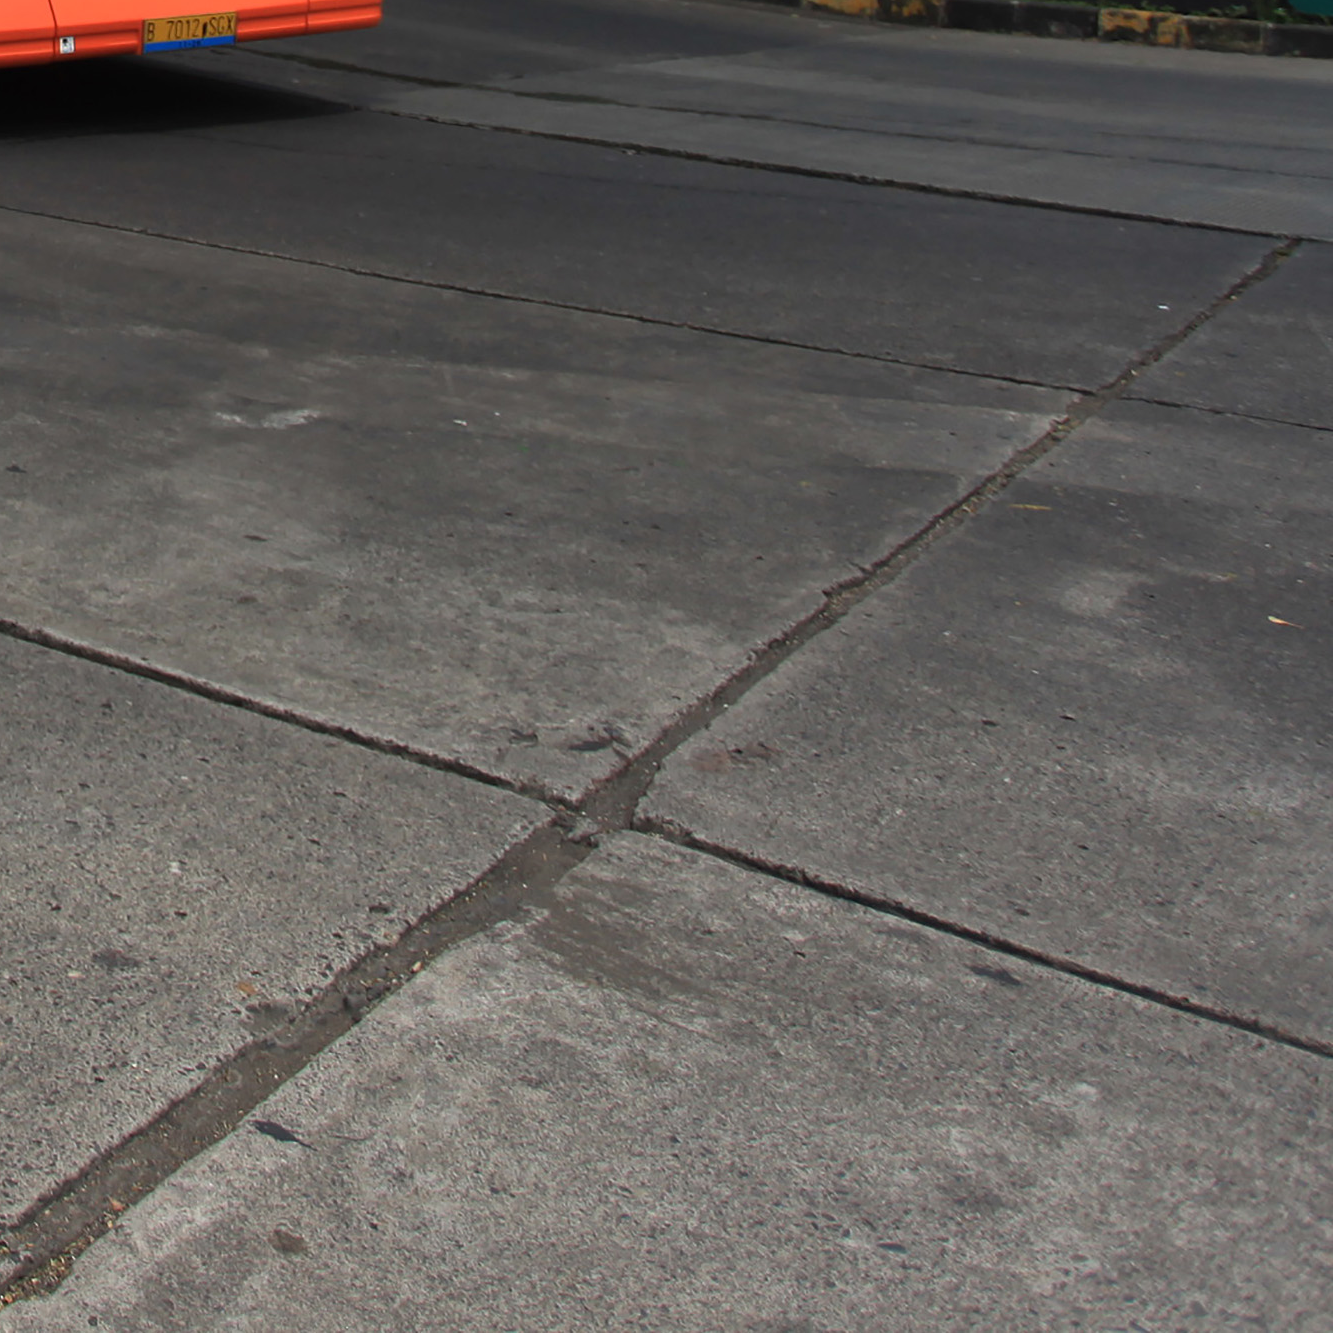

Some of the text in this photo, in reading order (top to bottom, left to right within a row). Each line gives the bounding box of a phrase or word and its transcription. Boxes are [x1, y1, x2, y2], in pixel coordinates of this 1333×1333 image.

[147, 15, 234, 42] B 7012 SGX
